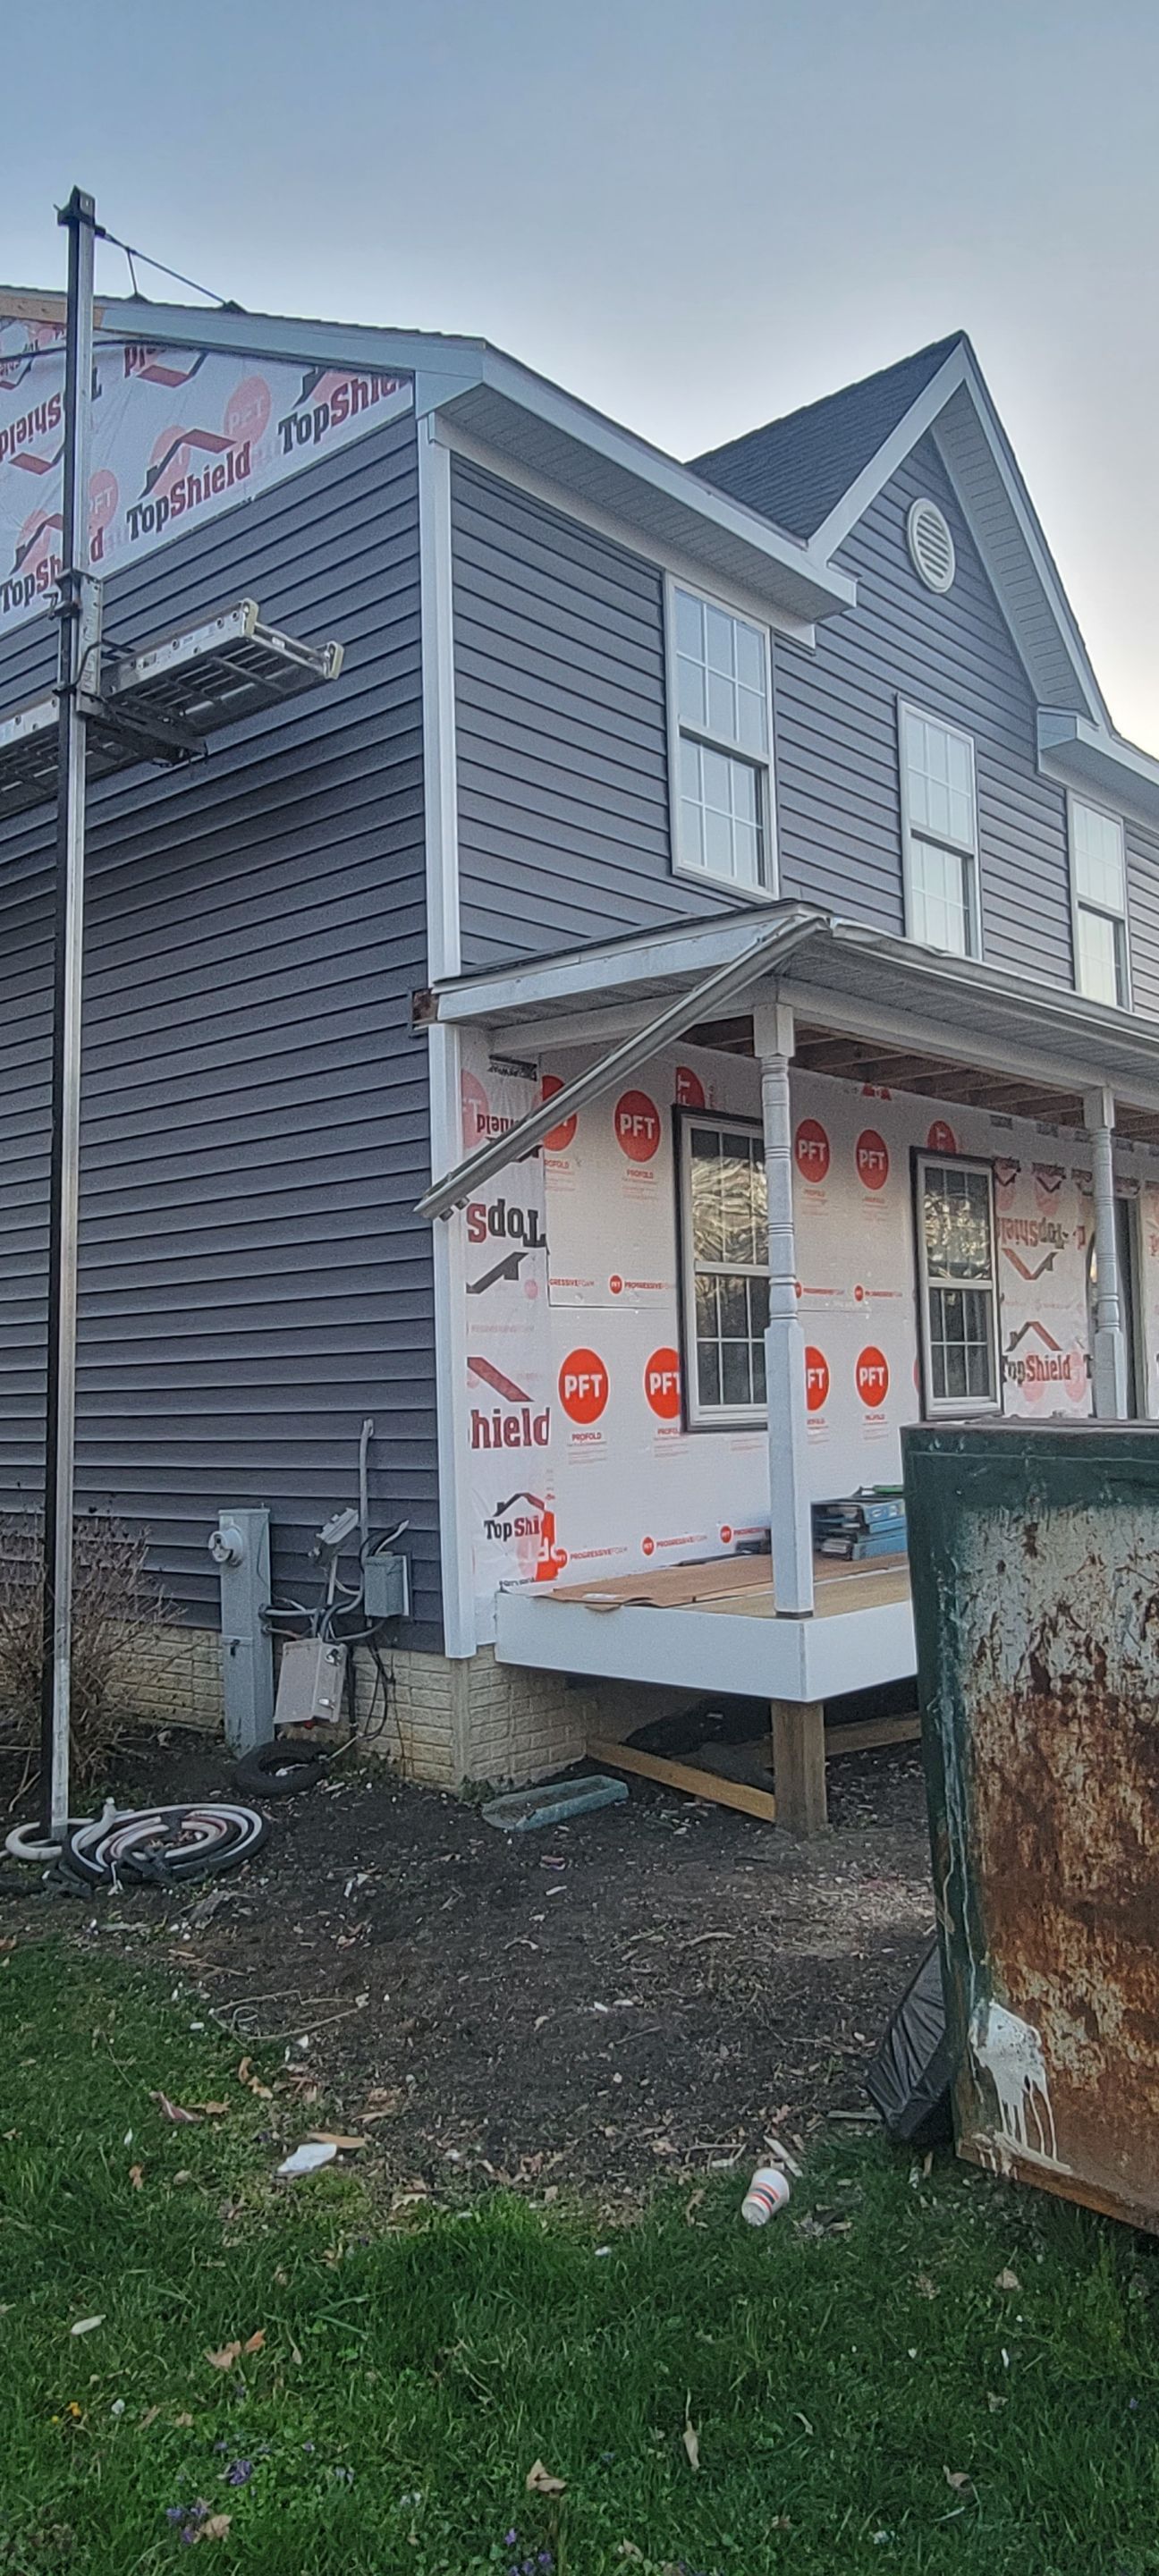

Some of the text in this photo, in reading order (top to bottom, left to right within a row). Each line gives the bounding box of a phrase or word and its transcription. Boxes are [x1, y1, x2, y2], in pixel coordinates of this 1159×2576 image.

[126, 440, 250, 541] TopShield
[620, 1114, 655, 1140] PFT
[798, 1140, 826, 1161] PFT
[859, 1149, 884, 1171] PFT
[564, 1374, 603, 1399] PFT
[808, 1368, 825, 1389] FT
[859, 1367, 884, 1386] PFT
[468, 1407, 550, 1449] hield
